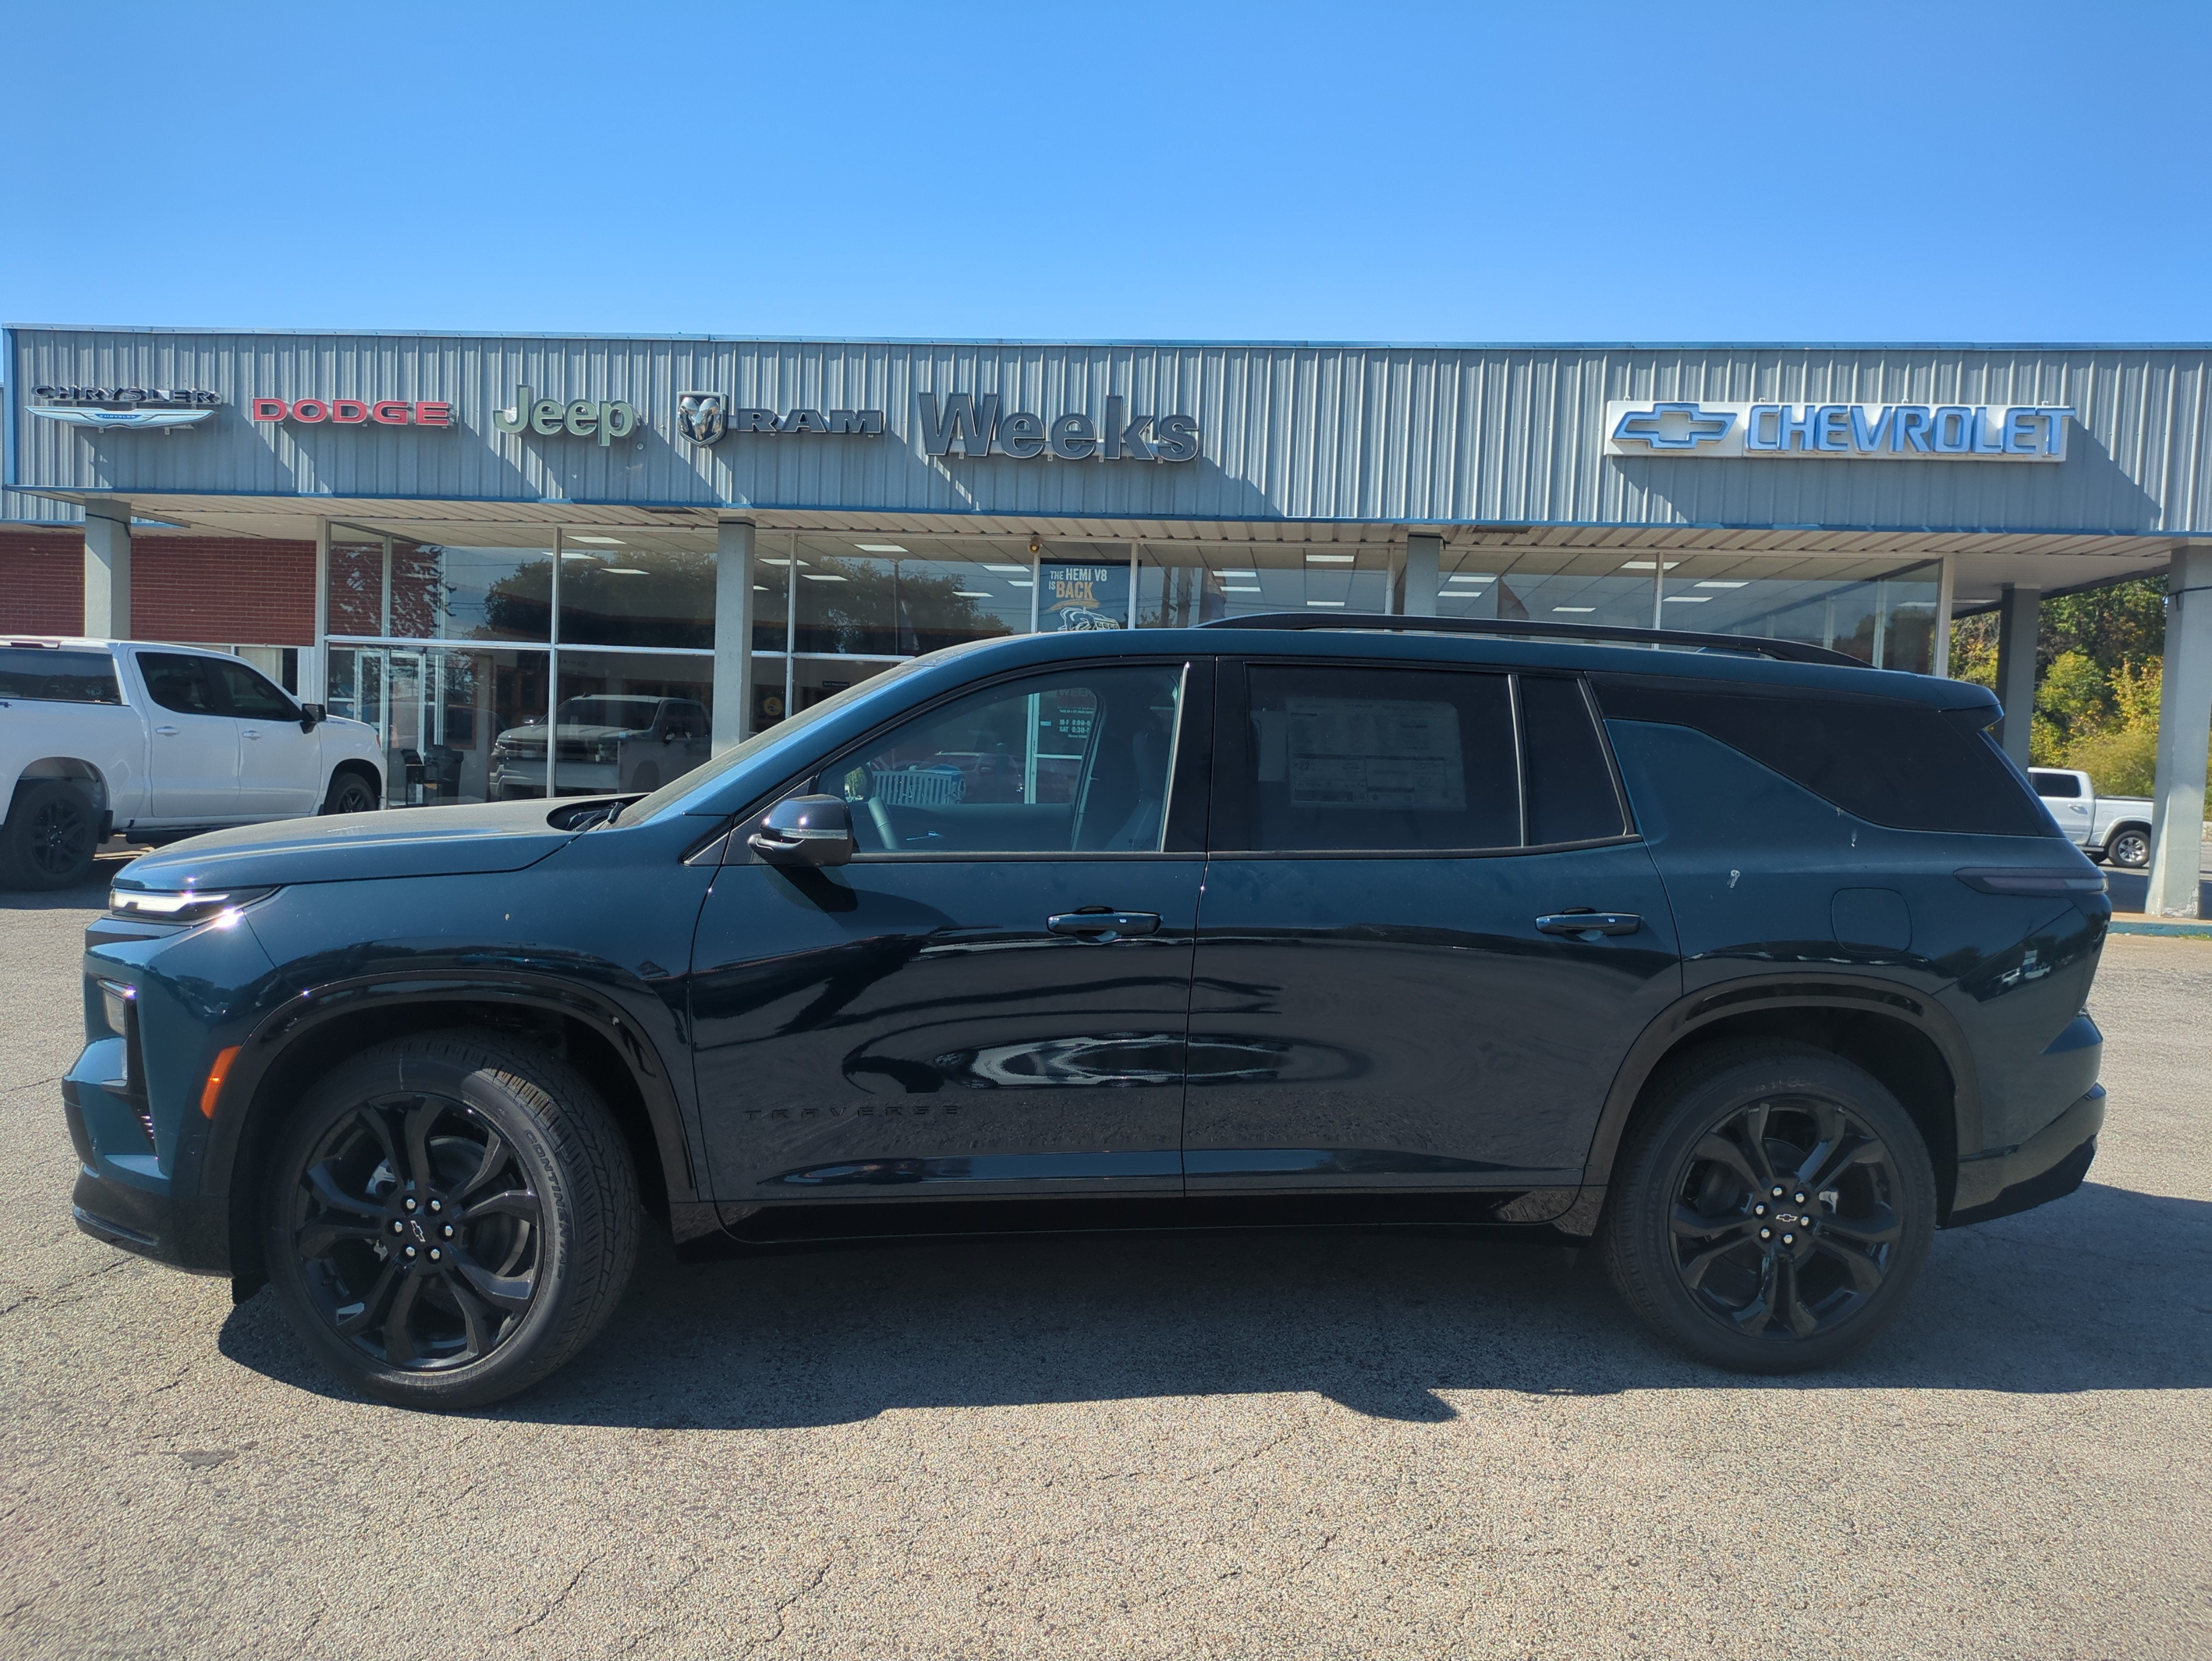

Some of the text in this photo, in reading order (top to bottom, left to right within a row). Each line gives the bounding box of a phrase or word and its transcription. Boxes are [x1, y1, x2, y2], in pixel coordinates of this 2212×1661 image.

[32, 385, 217, 403] CHRYSLER
[253, 398, 451, 425] DODGE
[493, 384, 636, 447] Jeep
[737, 408, 884, 434] RAM
[918, 392, 1199, 462] Weeks
[1745, 405, 2075, 455] CHEVROLET
[1050, 568, 1107, 581] THE HEMI V8
[1049, 581, 1094, 599] IS BACK
